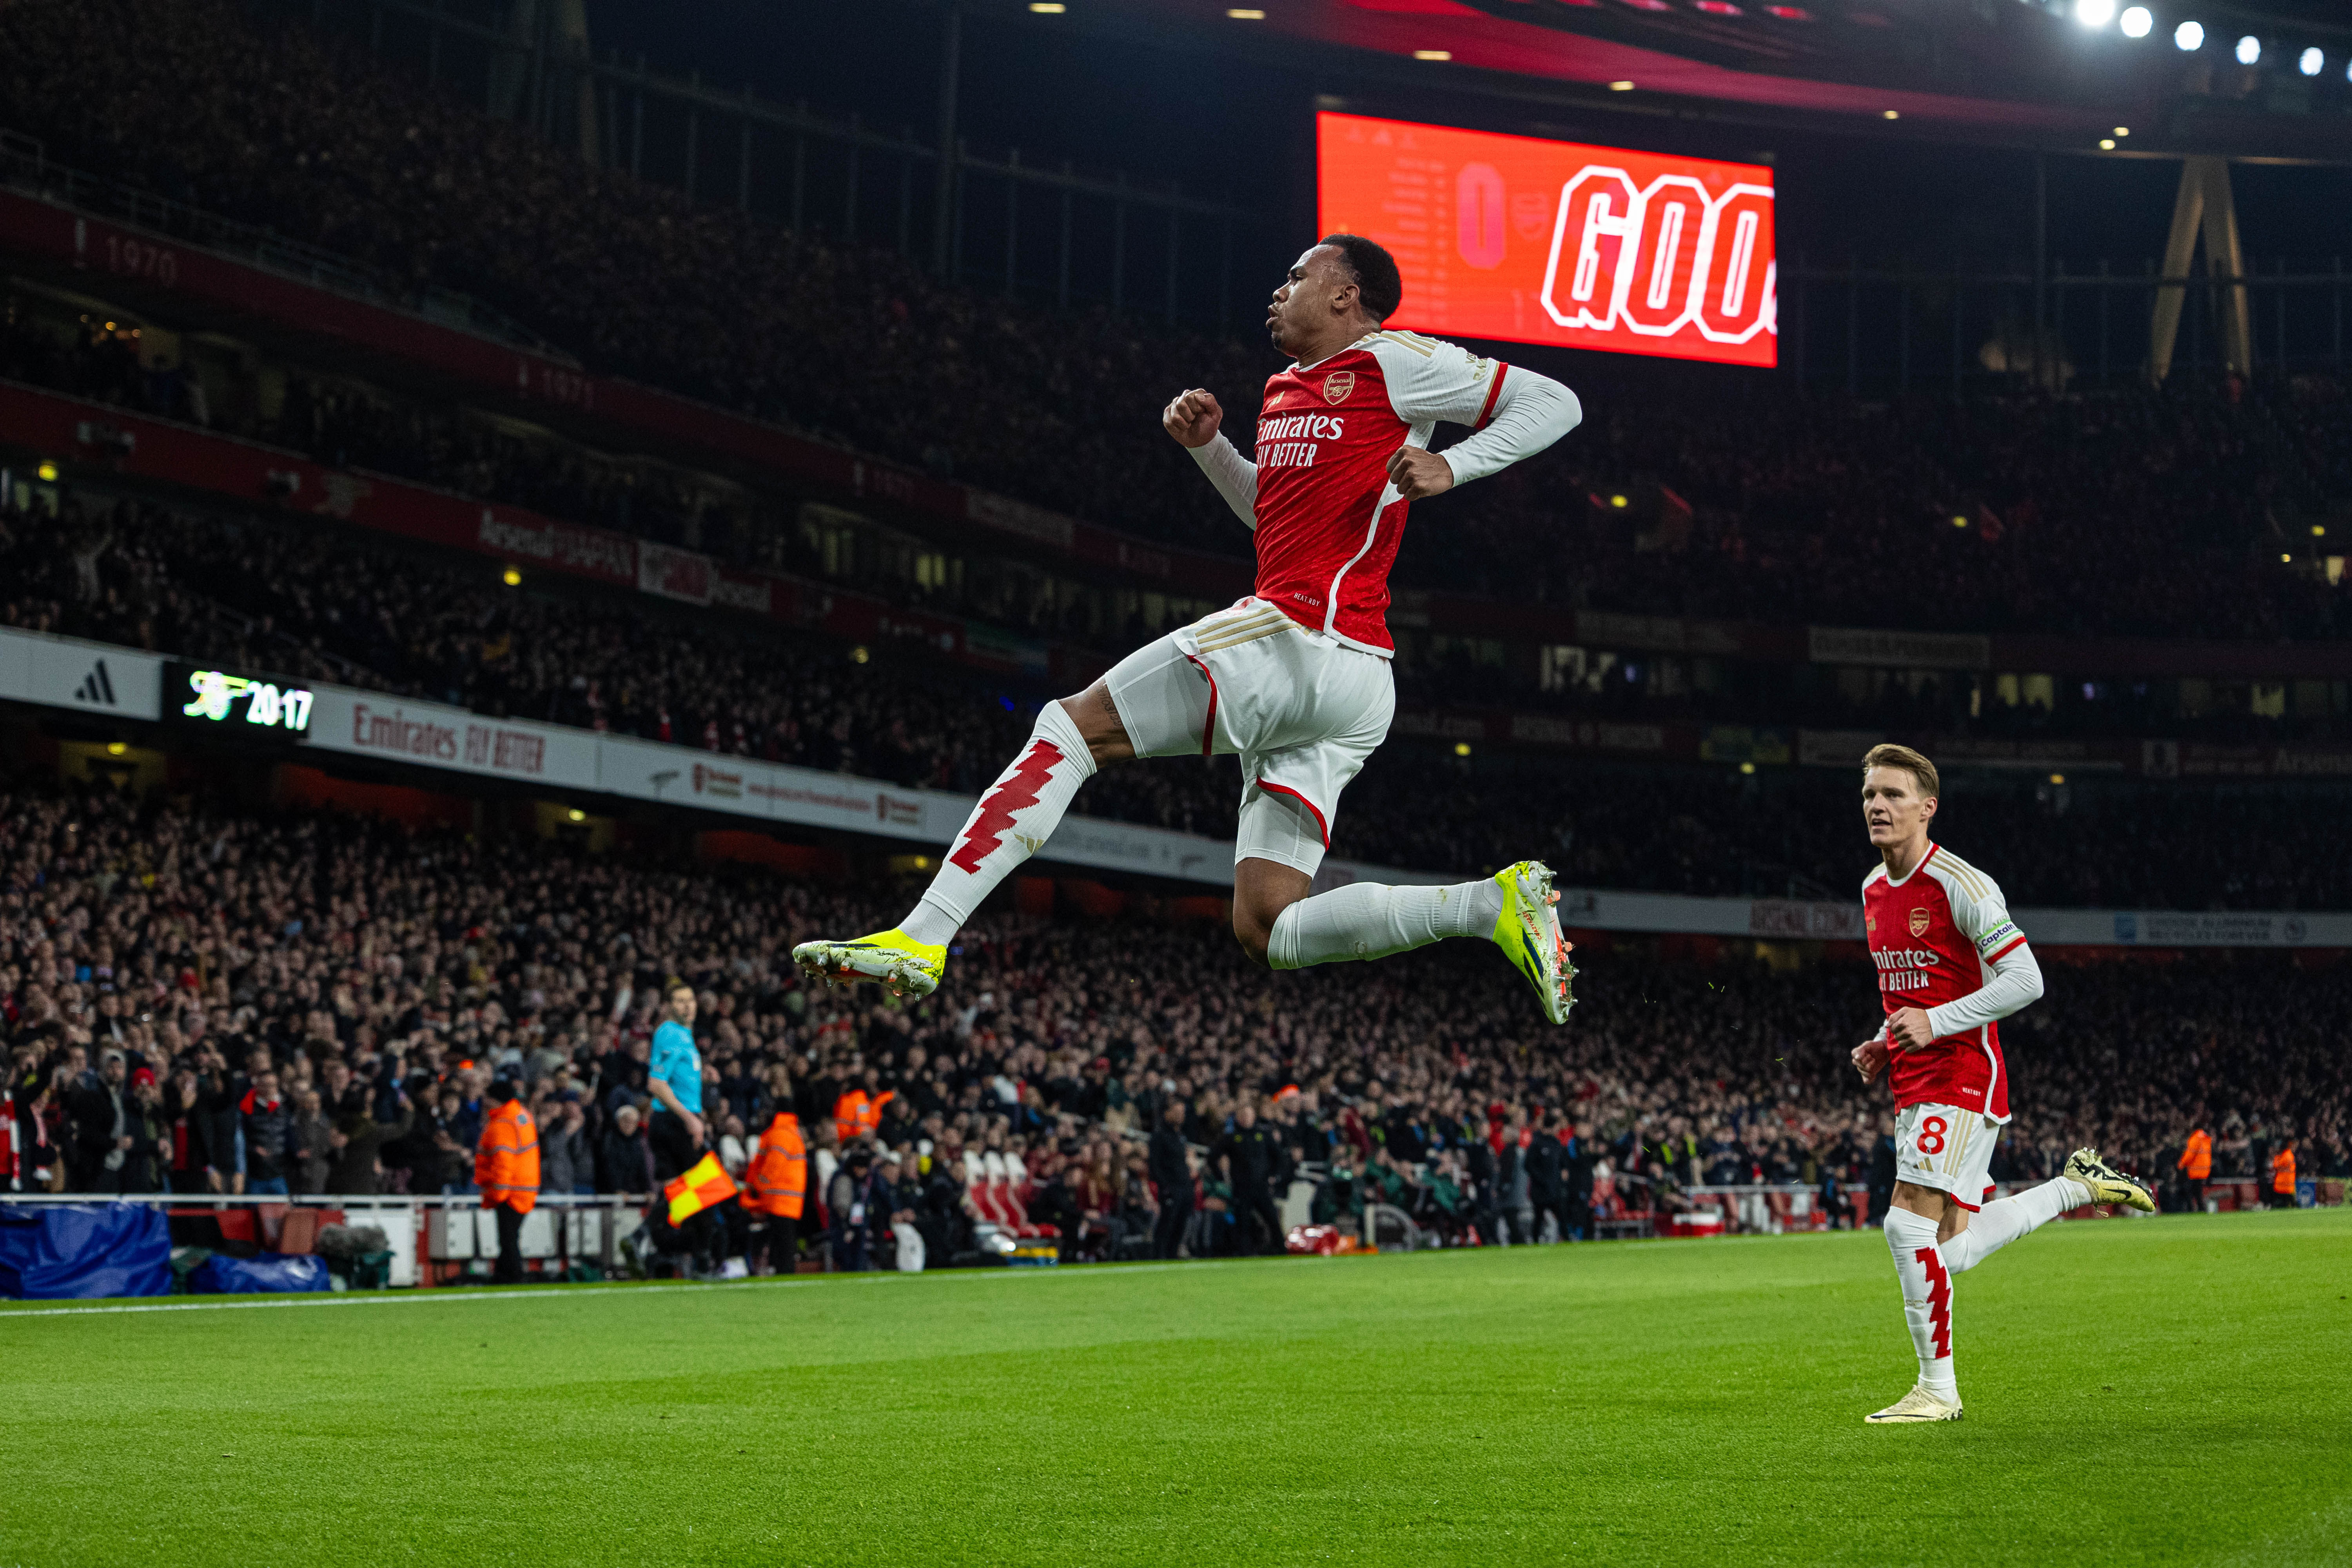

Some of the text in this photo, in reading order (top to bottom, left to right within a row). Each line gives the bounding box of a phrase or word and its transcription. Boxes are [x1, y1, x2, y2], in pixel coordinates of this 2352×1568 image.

[1541, 165, 1778, 345] GOO
[1255, 411, 1344, 440] Emirates
[1270, 443, 1318, 467] BETTER
[1294, 592, 1320, 607] HEAT.RDY
[246, 681, 314, 731] 20:17
[353, 704, 457, 760] Emirates
[1871, 945, 1940, 969] mirates
[1889, 970, 1929, 991] BETTER
[1917, 1116, 1947, 1154] 8
